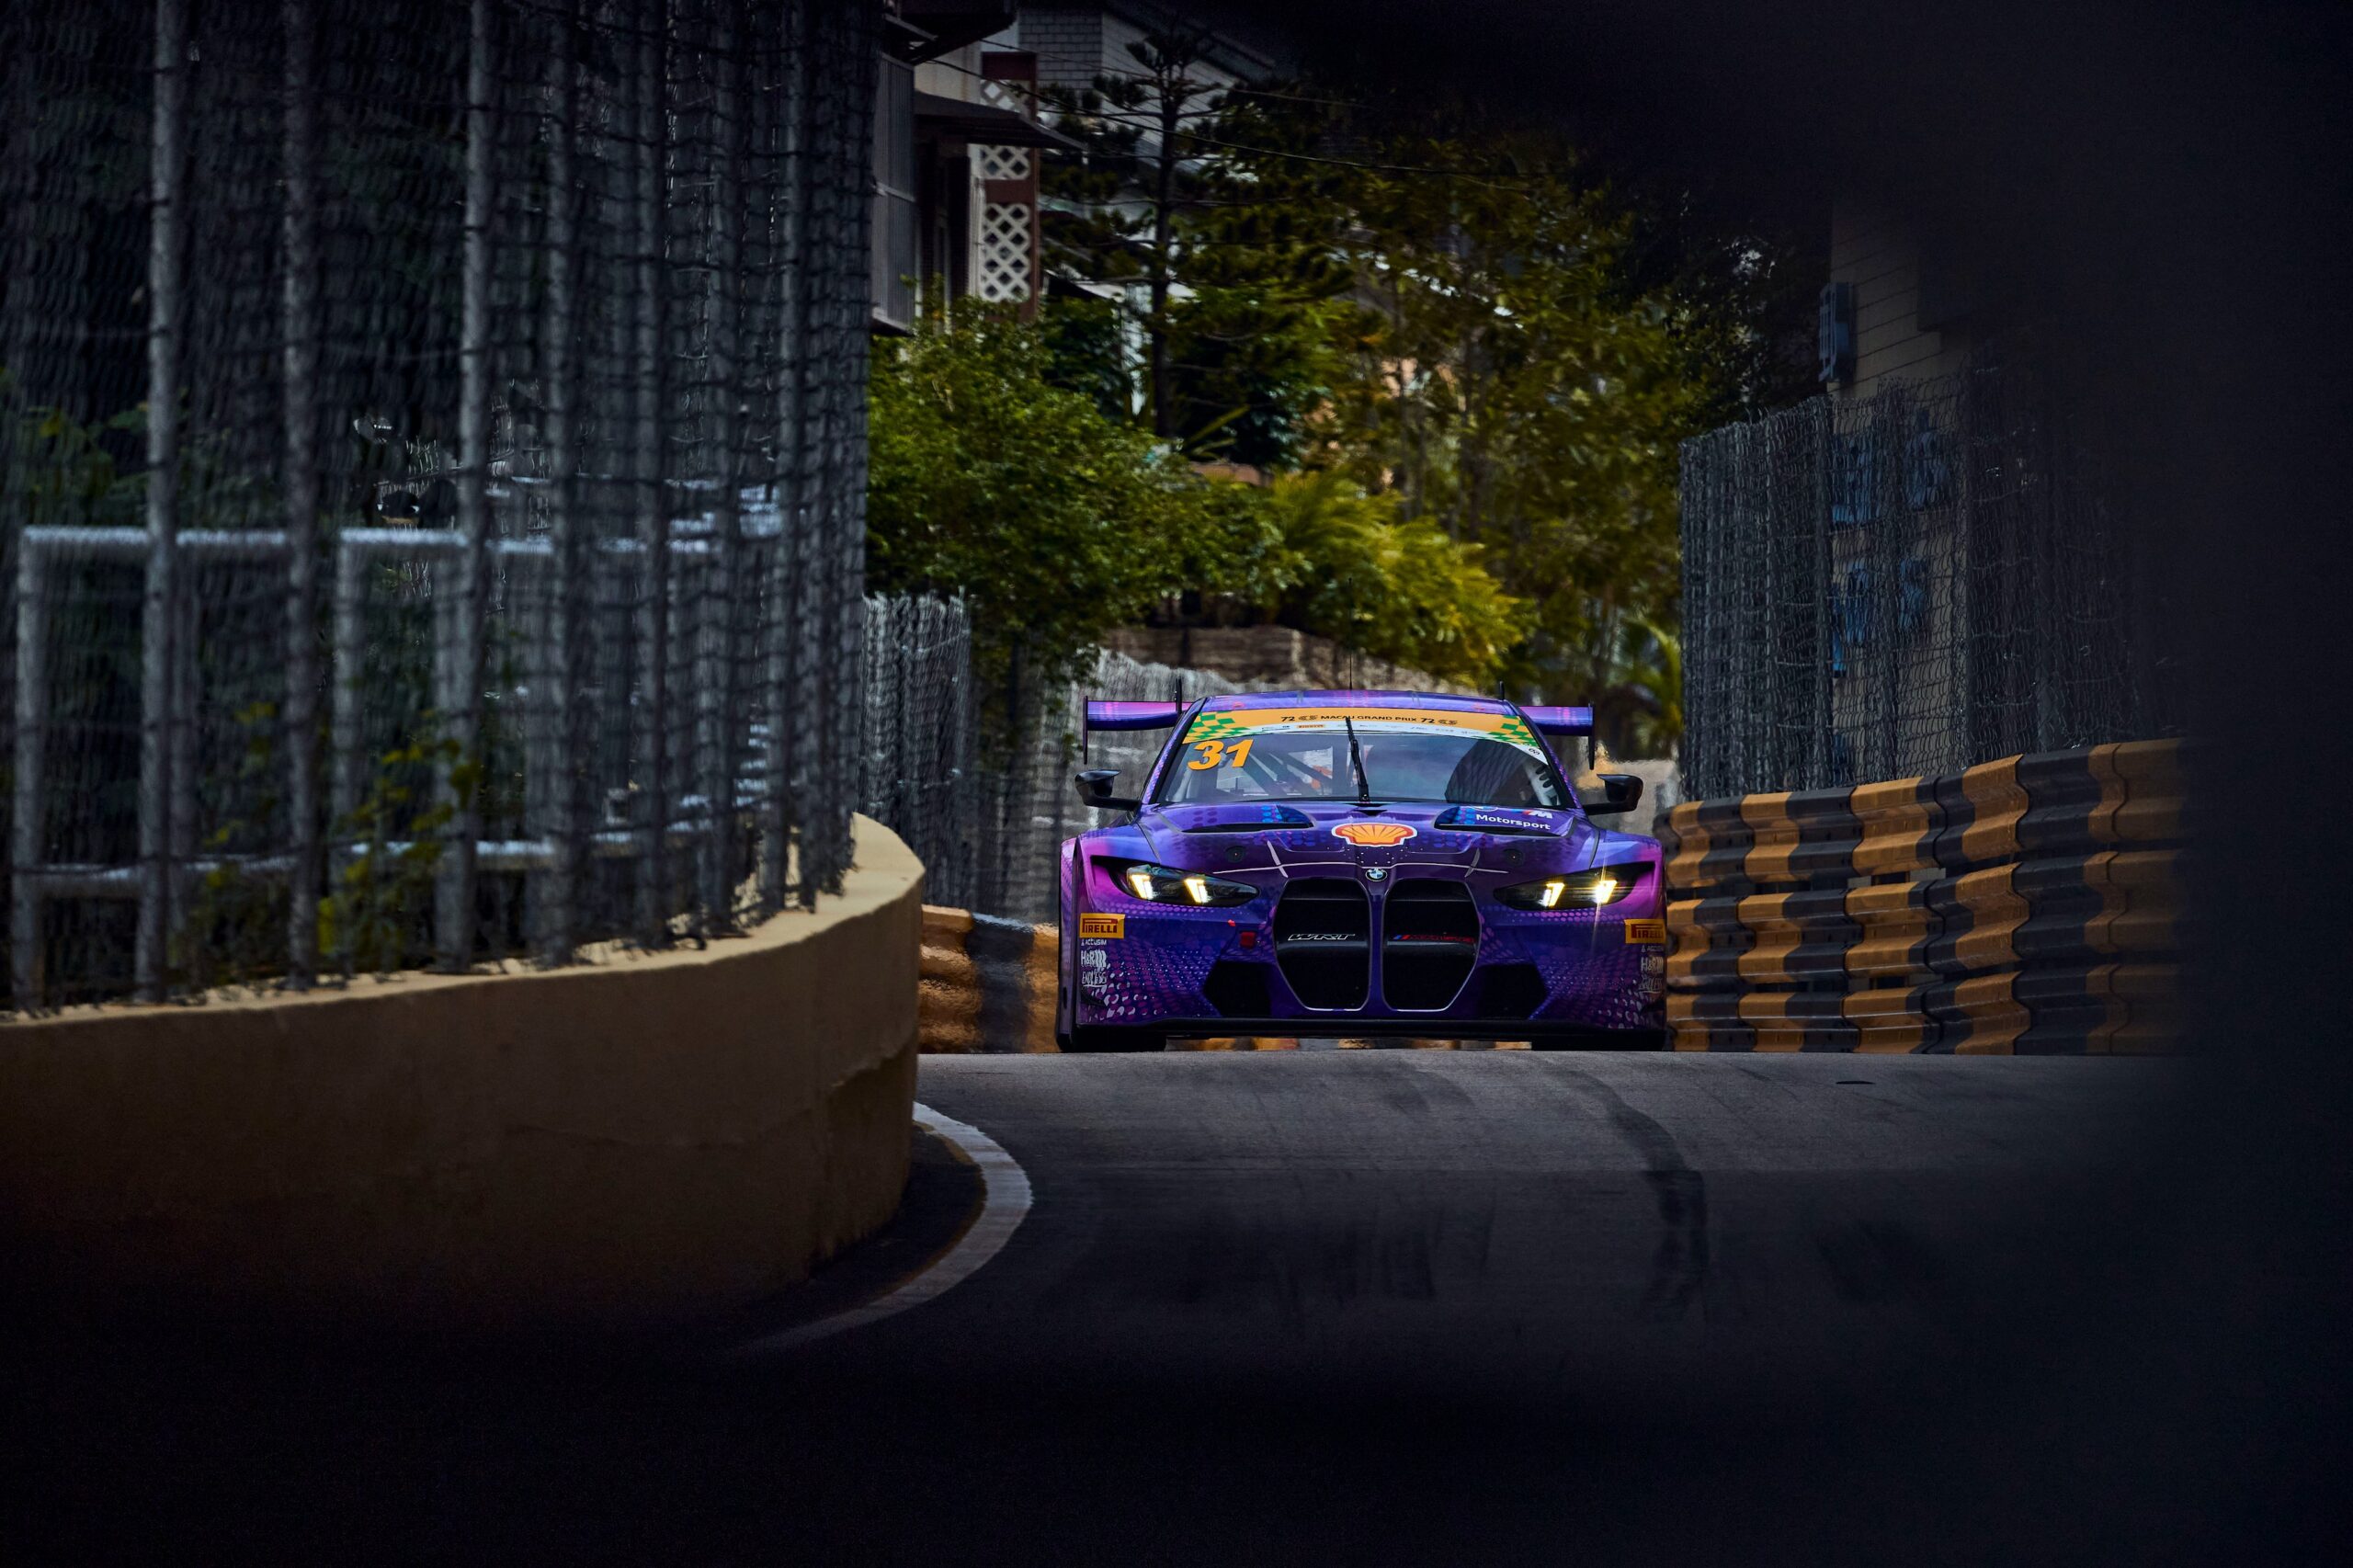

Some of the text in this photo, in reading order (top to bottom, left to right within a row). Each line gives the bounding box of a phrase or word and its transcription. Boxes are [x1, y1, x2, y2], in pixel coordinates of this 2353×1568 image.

[1187, 739, 1254, 771] 31
[1476, 813, 1552, 830] Motorsport
[1082, 918, 1119, 933] PIRELLI
